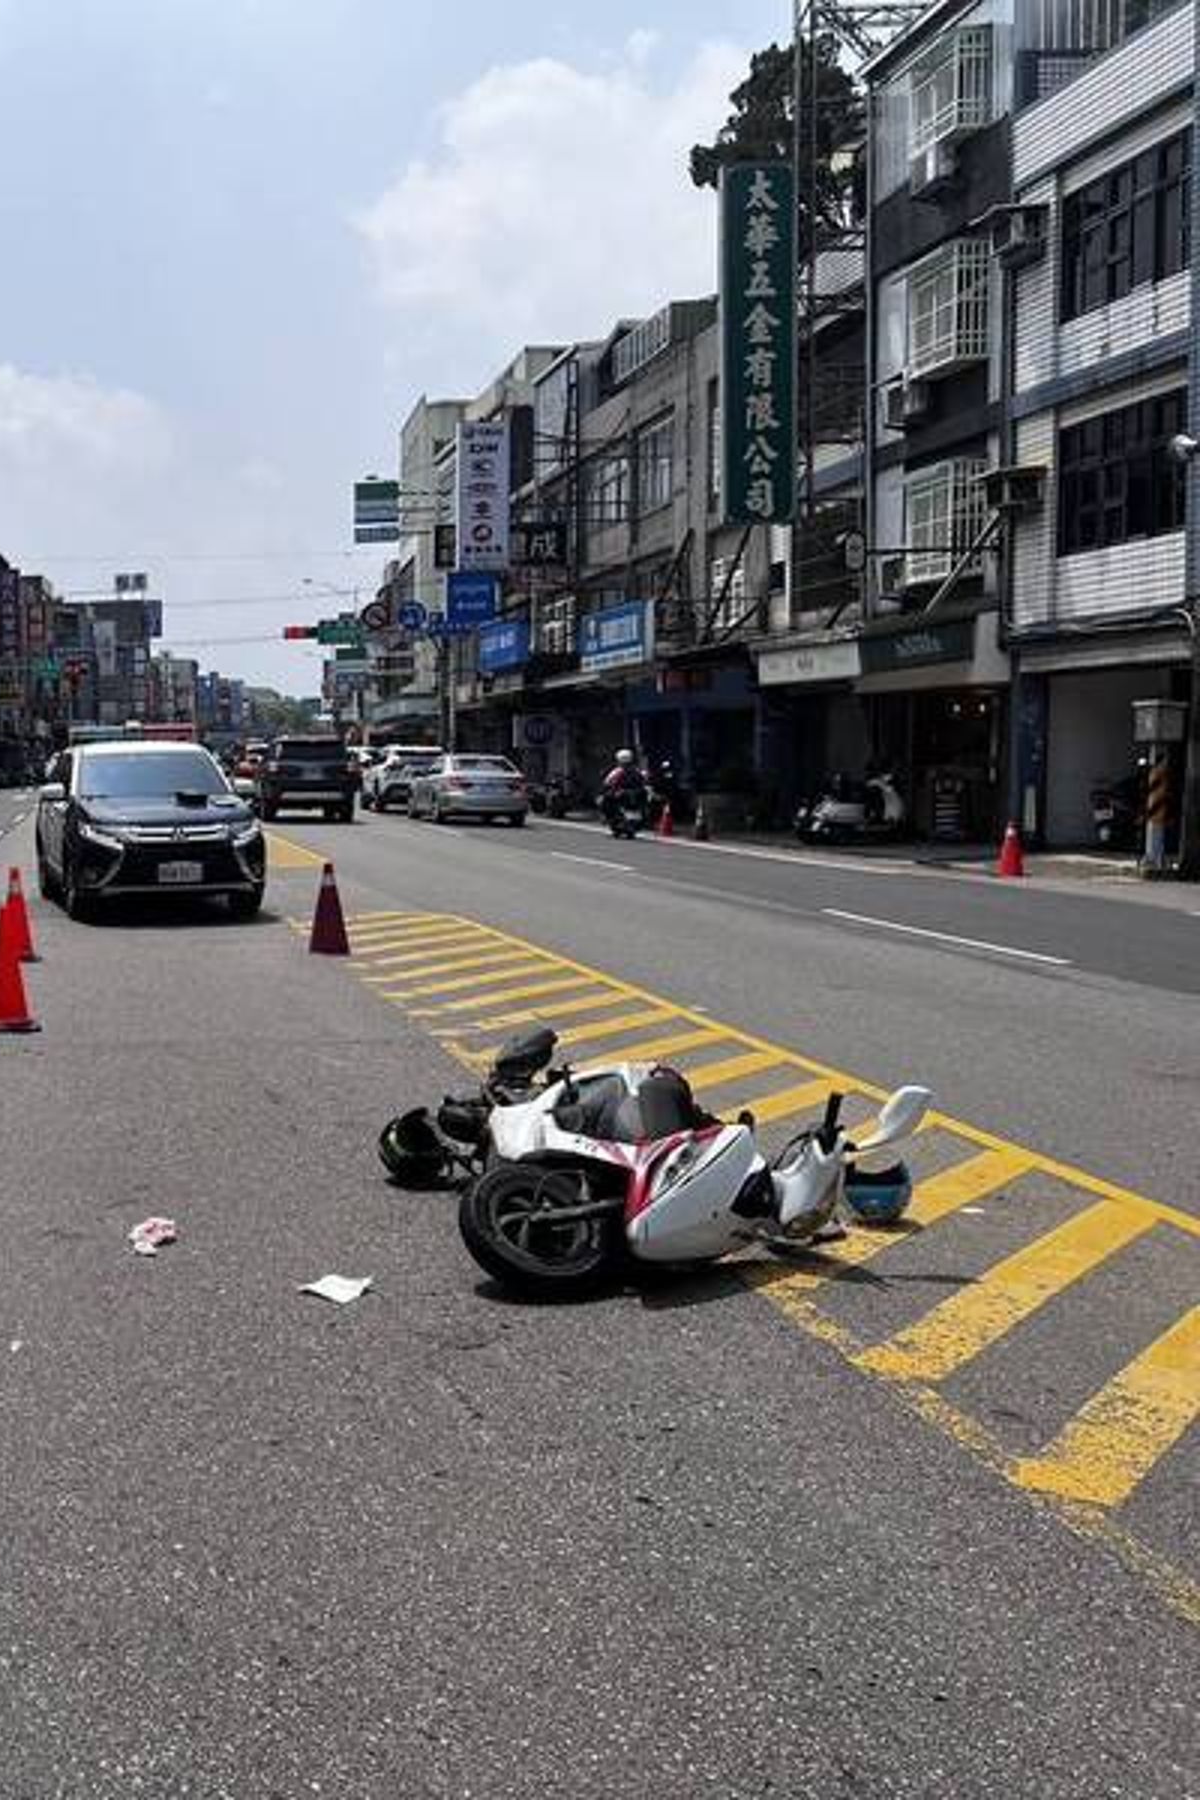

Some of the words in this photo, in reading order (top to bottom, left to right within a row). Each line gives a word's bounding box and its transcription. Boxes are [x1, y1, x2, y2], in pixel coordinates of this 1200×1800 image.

[743, 170, 781, 517] 太華五金有限公司
